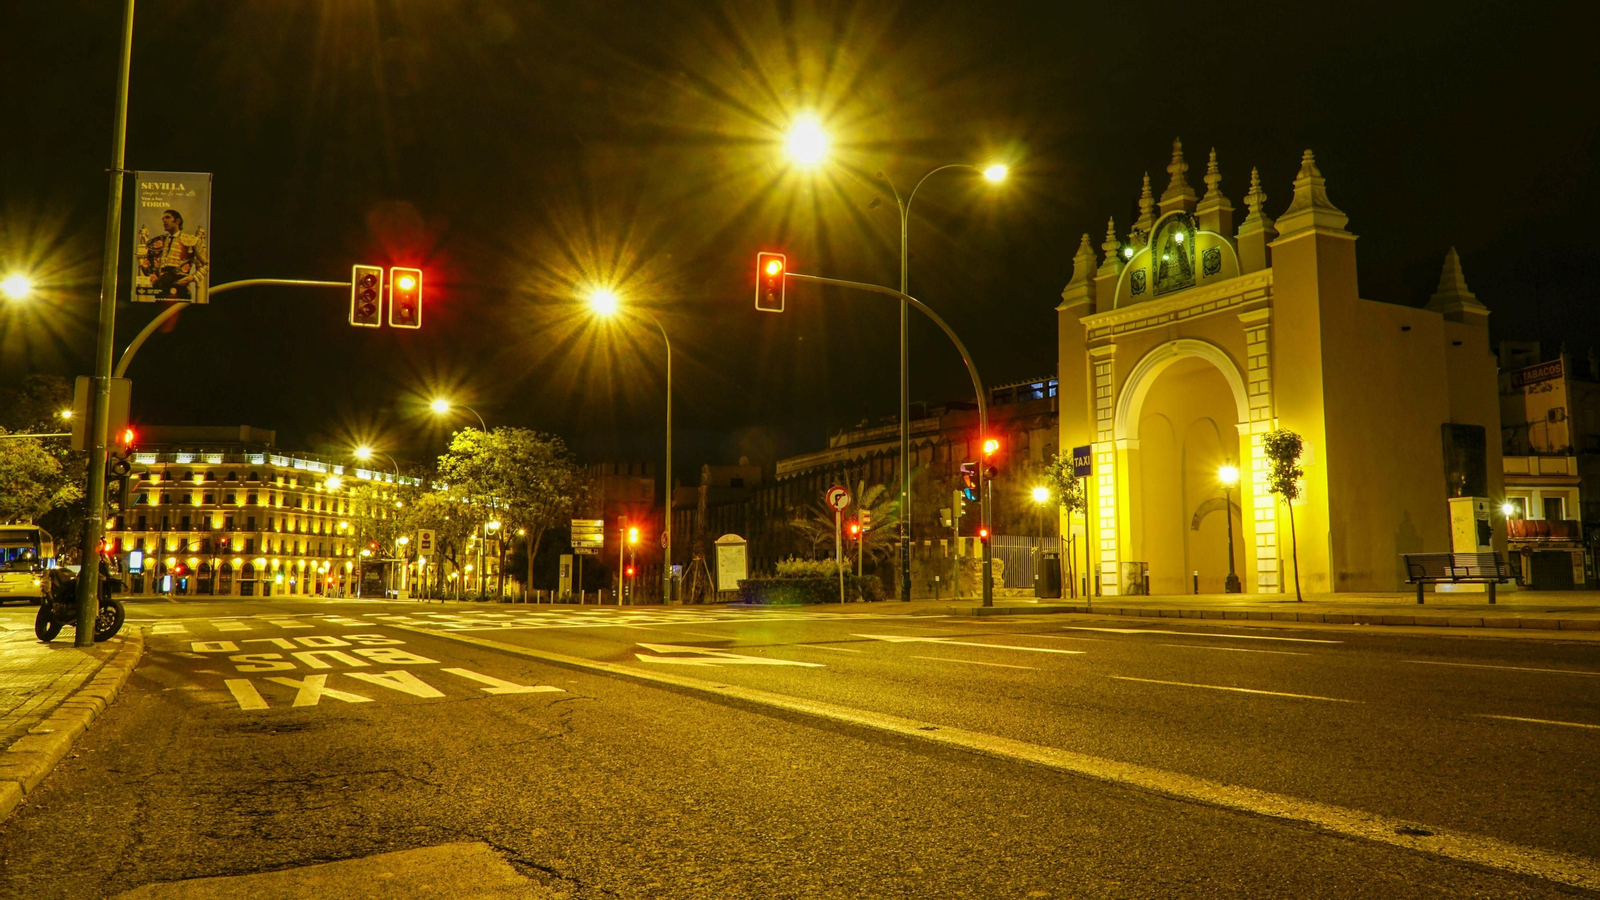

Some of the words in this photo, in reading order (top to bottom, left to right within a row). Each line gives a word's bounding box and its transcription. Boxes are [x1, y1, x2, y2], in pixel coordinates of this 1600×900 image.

[141, 182, 185, 190] SEVILLA
[1523, 364, 1561, 381] TABACOS
[1074, 455, 1090, 468] TAXI
[191, 634, 406, 652] SOLO
[229, 647, 441, 672] BUS
[224, 668, 566, 710] TAXI
